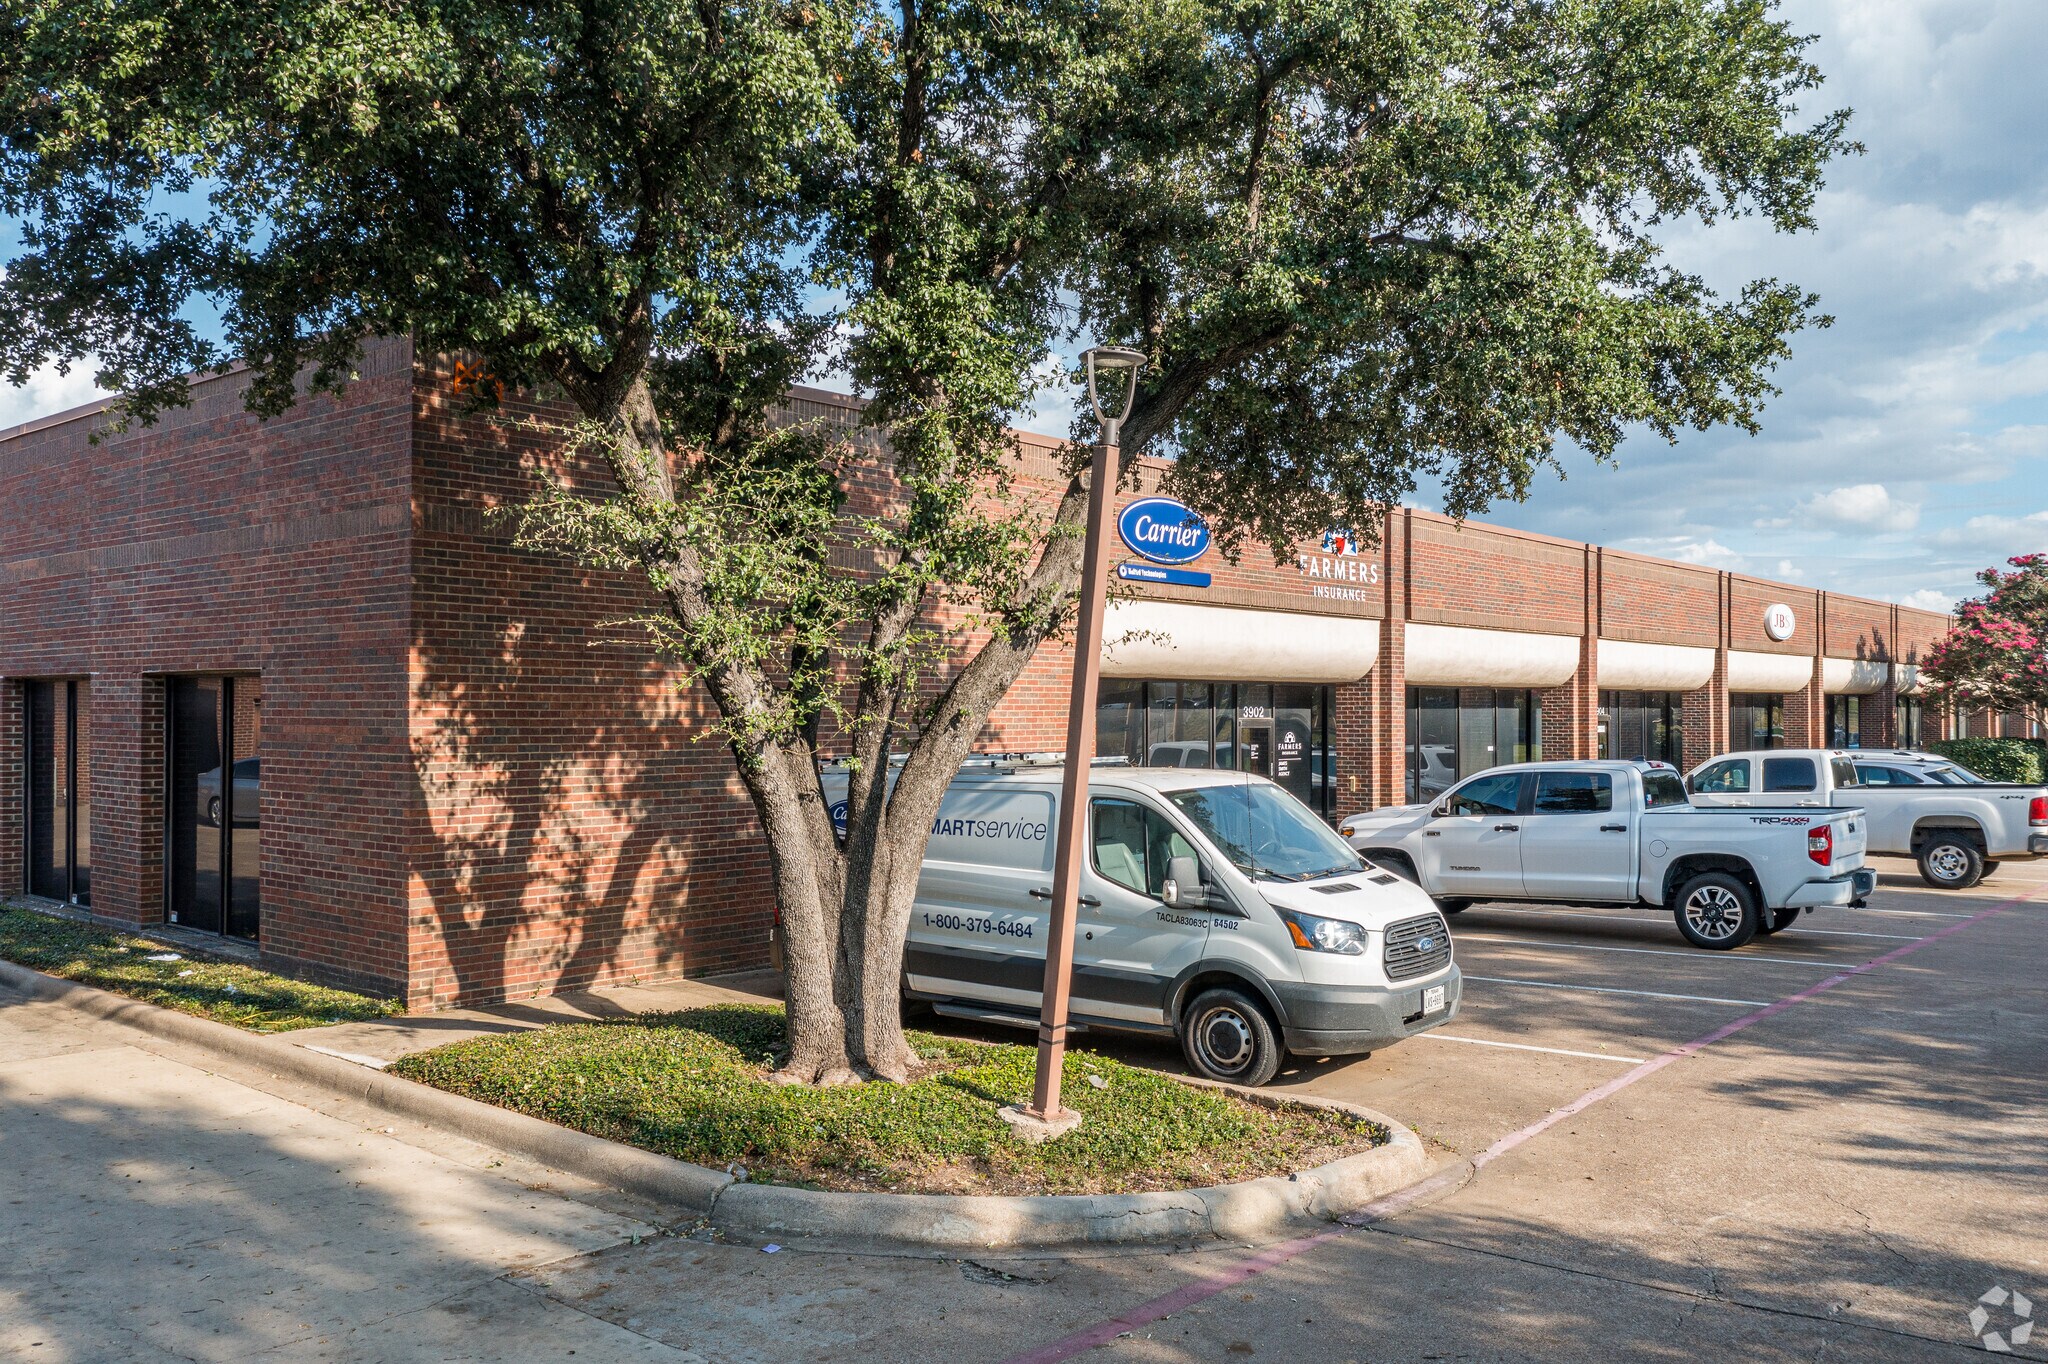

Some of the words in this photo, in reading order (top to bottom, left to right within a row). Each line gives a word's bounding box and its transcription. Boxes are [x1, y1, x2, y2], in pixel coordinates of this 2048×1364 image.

[1135, 515, 1201, 547] Carrier
[1300, 554, 1378, 584] FARMERS
[1313, 586, 1366, 602] INSURANCE
[1243, 706, 1264, 718] 3902
[923, 912, 1033, 939] 1-800-379-6484
[1156, 911, 1208, 929] TACLA83063C
[1213, 918, 1239, 931] 64502
